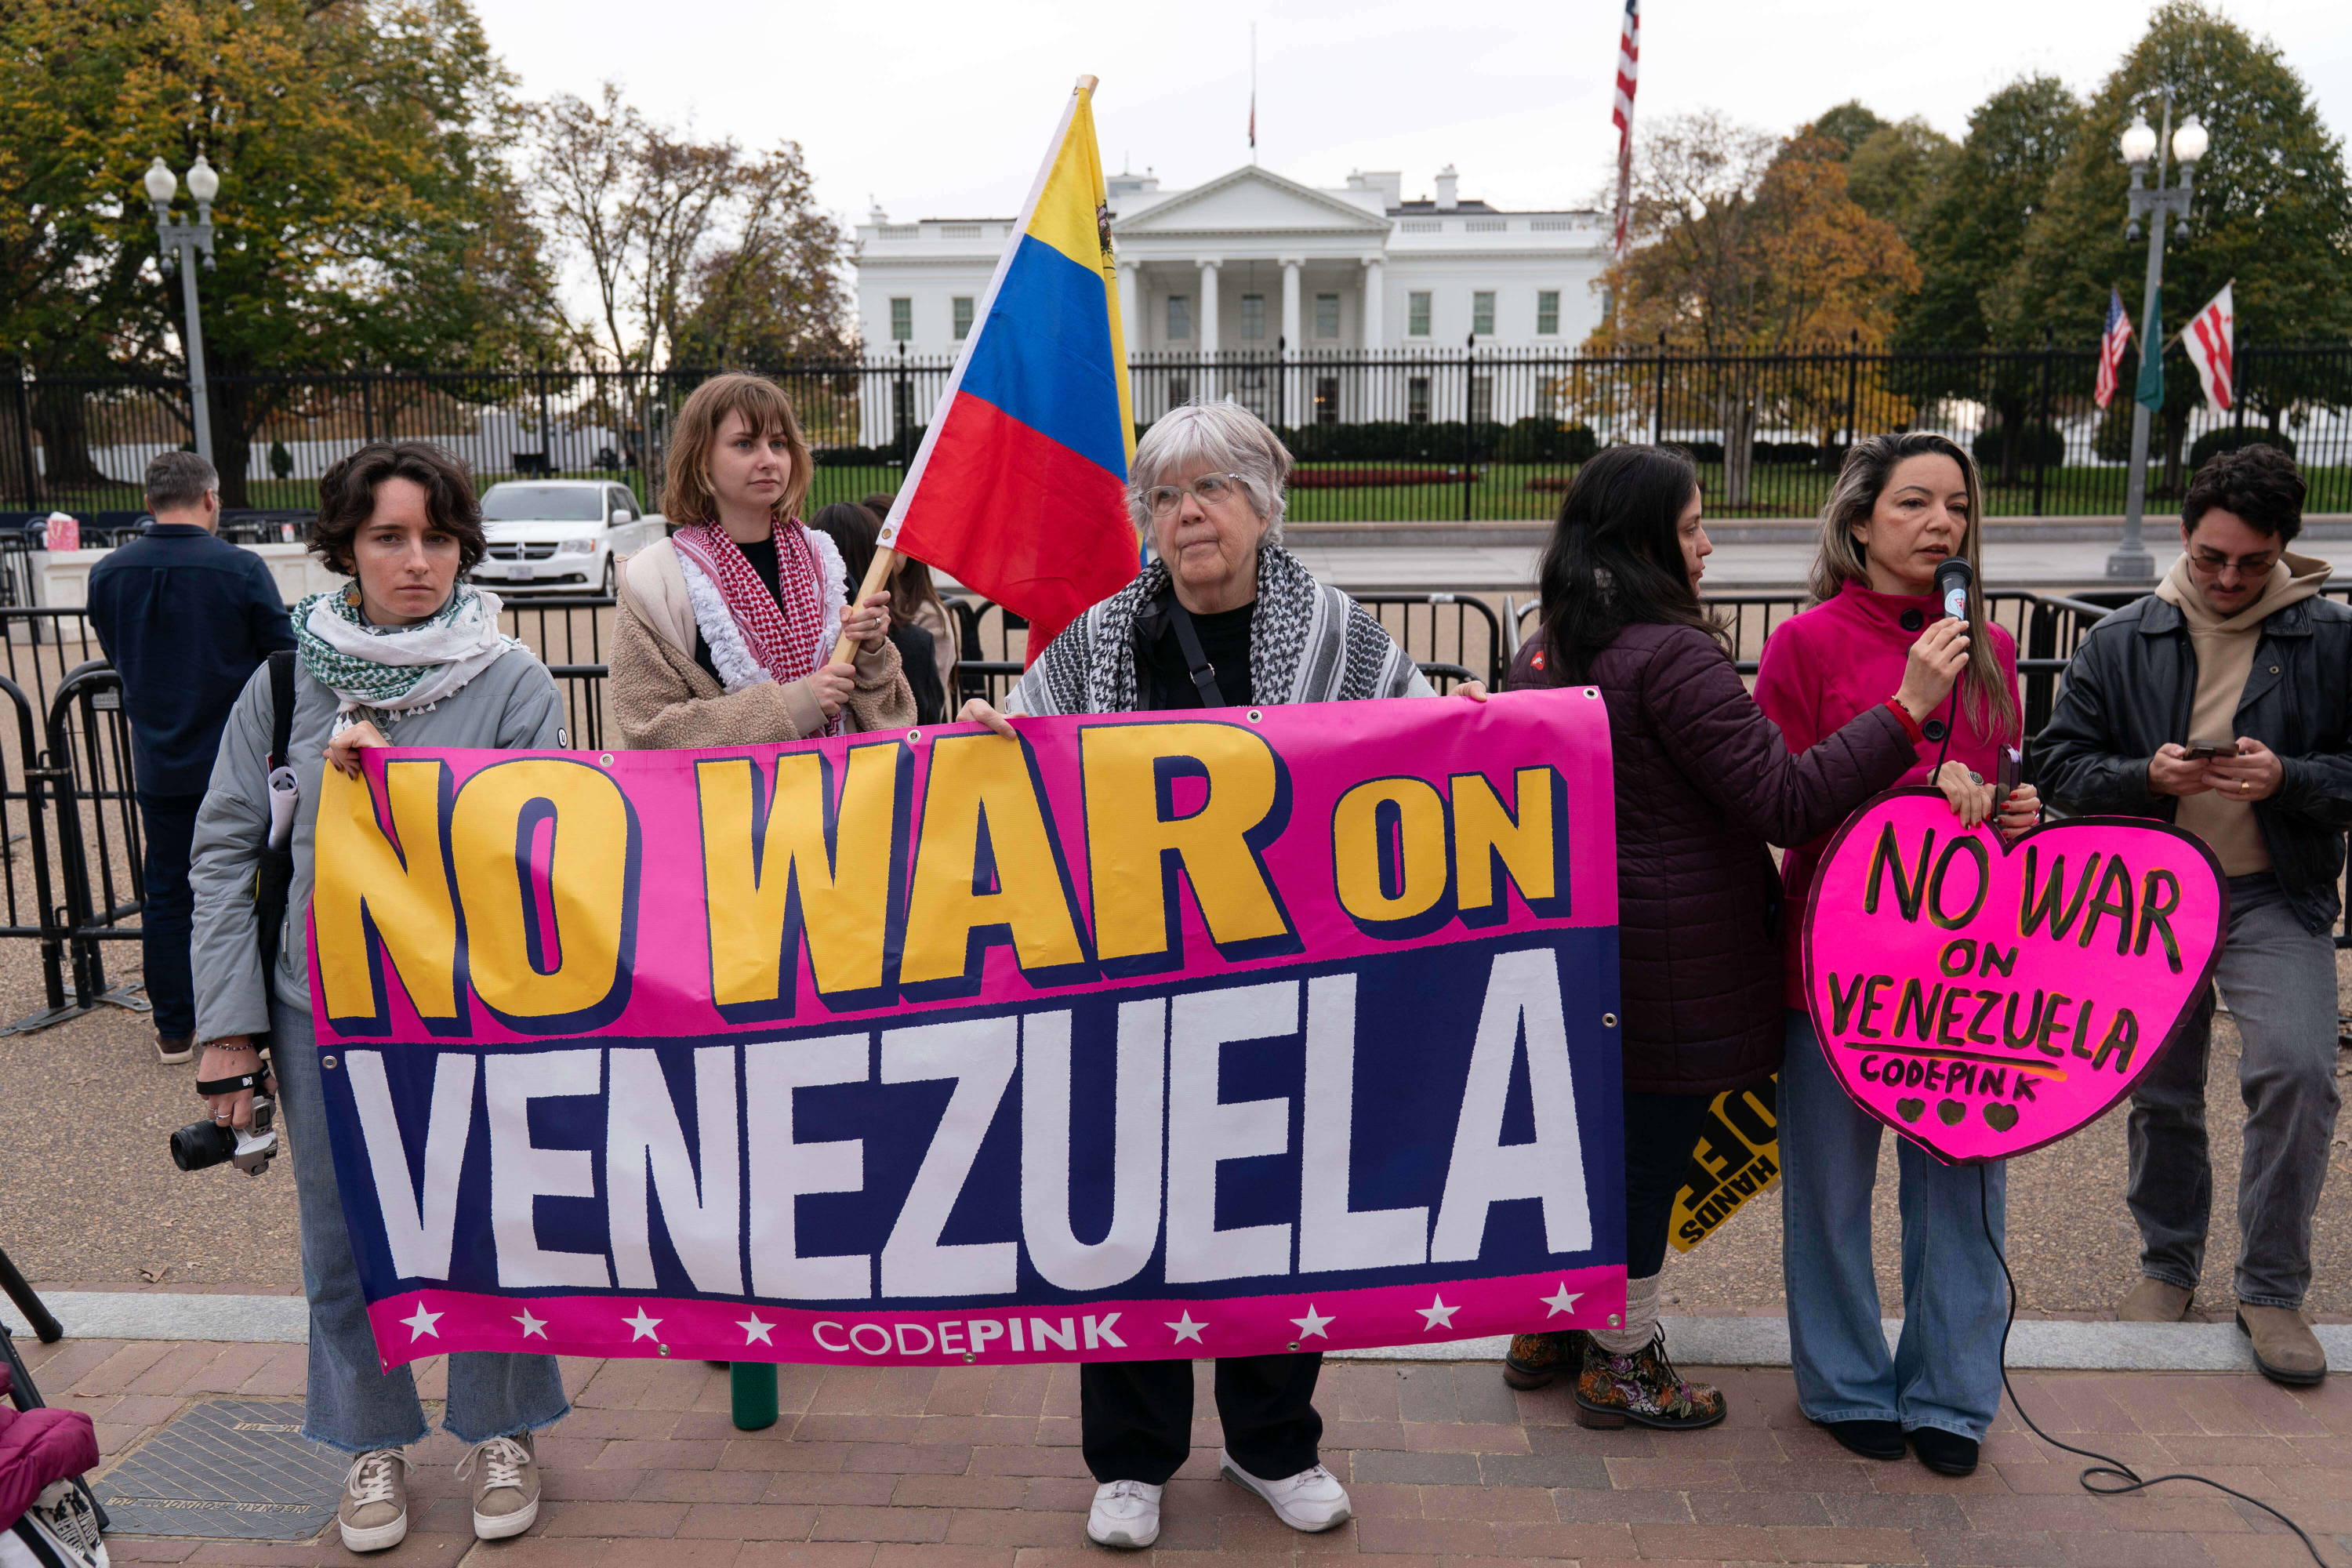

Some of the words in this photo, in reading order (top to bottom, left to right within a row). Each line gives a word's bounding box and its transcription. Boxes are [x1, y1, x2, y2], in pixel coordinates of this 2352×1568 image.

[314, 756, 642, 1038] NO
[694, 720, 1306, 1024] WAR
[1330, 764, 1572, 941] ON
[1864, 821, 1989, 931] NO
[2018, 844, 2183, 974] WAR
[1938, 938, 2019, 978] ON
[1828, 972, 2139, 1074] VENEZUELA
[344, 948, 1593, 1300] VENEZUELA
[1860, 1054, 2042, 1102] CODEPINK
[1679, 1154, 1779, 1244] HANDS
[812, 1312, 1128, 1356] CODEPINK
